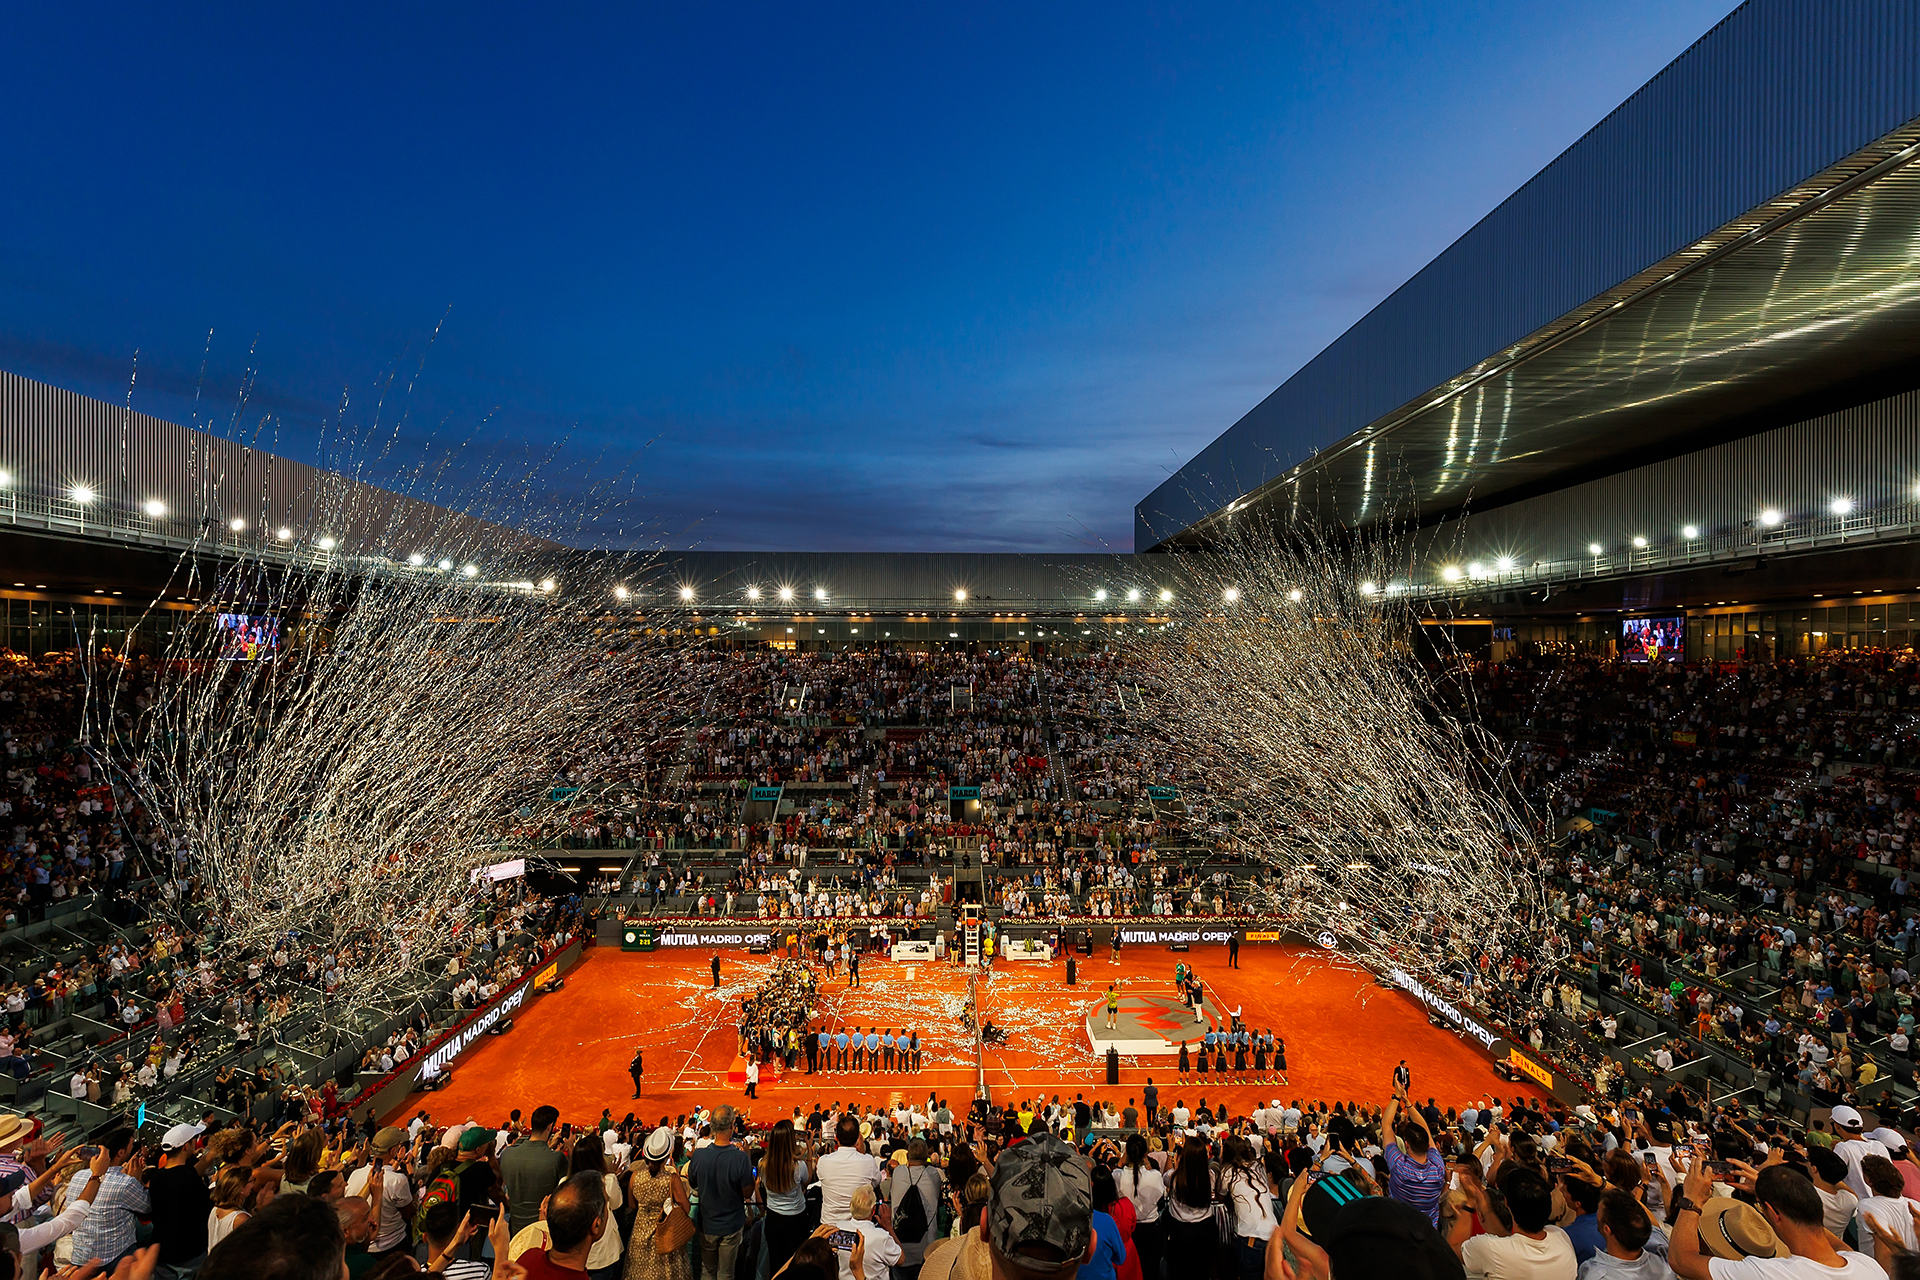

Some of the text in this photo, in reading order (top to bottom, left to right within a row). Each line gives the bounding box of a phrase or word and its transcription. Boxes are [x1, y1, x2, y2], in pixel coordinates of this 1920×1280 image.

[952, 789, 978, 797] MARCA
[660, 933, 699, 946] MUTUA
[700, 934, 743, 944] MADRID
[1120, 931, 1235, 943] MUTUA MADRID OPEN
[1425, 989, 1463, 1025] MADRID
[1463, 1016, 1498, 1048] OPEN
[422, 984, 527, 1081] MUTUA MADRID OPEN
[1515, 1054, 1547, 1082] FINALS
